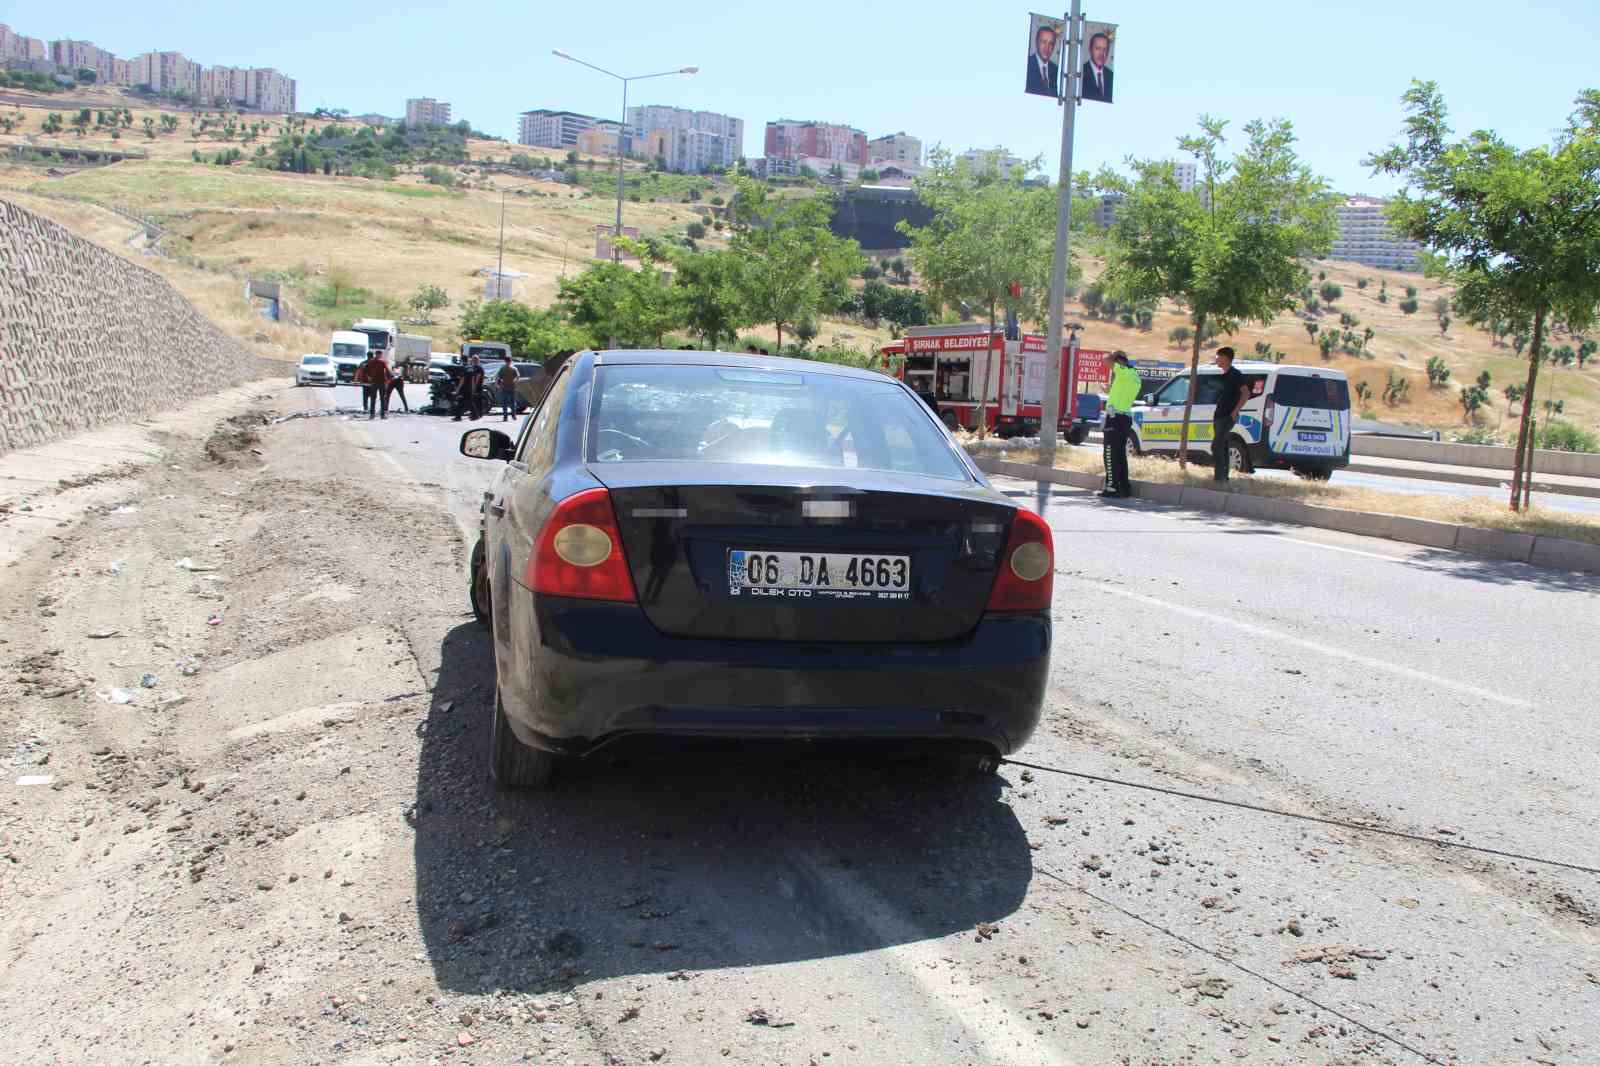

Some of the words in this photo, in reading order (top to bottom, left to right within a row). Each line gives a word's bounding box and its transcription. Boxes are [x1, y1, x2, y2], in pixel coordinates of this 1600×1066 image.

[1136, 368, 1150, 377] OTO
[748, 554, 780, 585] 06
[800, 555, 831, 587] DA
[845, 557, 907, 588] 4663
[788, 589, 812, 598] OTO
